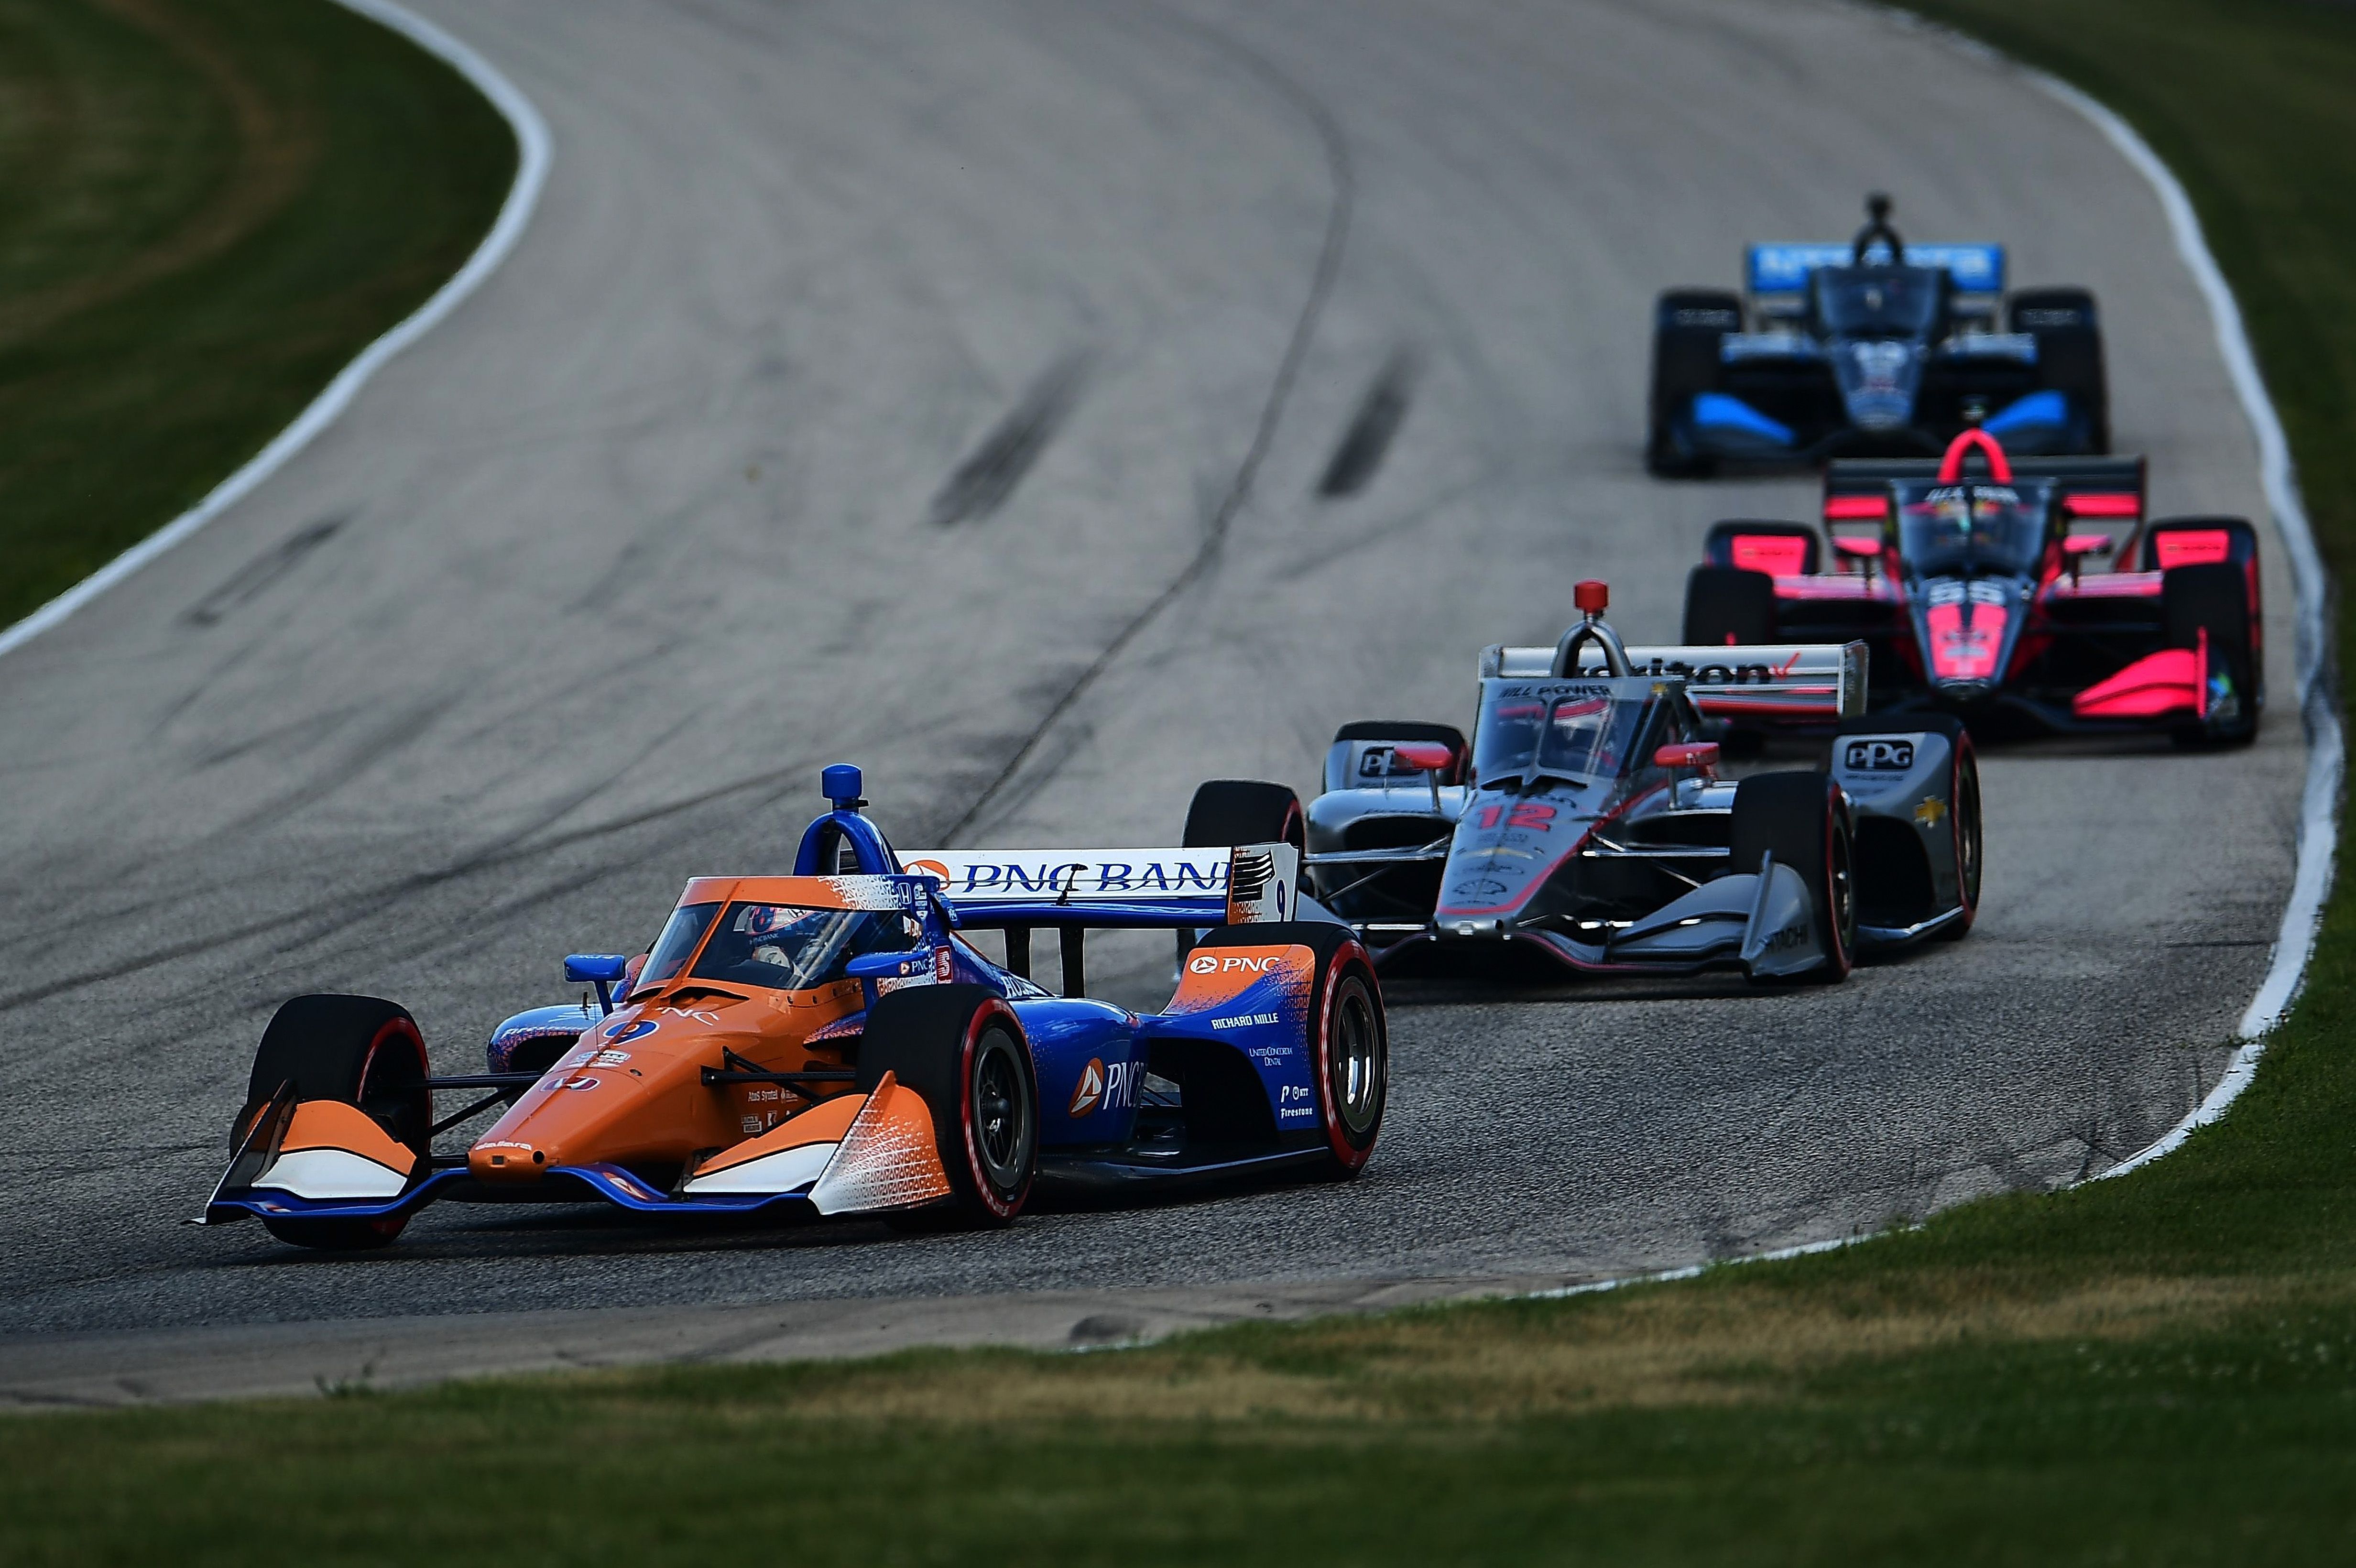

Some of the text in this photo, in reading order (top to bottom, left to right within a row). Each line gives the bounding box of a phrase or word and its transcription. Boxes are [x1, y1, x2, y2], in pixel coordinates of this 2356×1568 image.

[1538, 685, 1612, 695] POWER
[1849, 743, 1911, 767] PPG
[1477, 804, 1557, 831] 12
[962, 863, 1076, 893] PNC
[912, 959, 928, 972] PNC
[1222, 957, 1280, 972] PNC
[1211, 1012, 1279, 1030] RICHARD MILLE
[1280, 1107, 1313, 1120] Firestone
